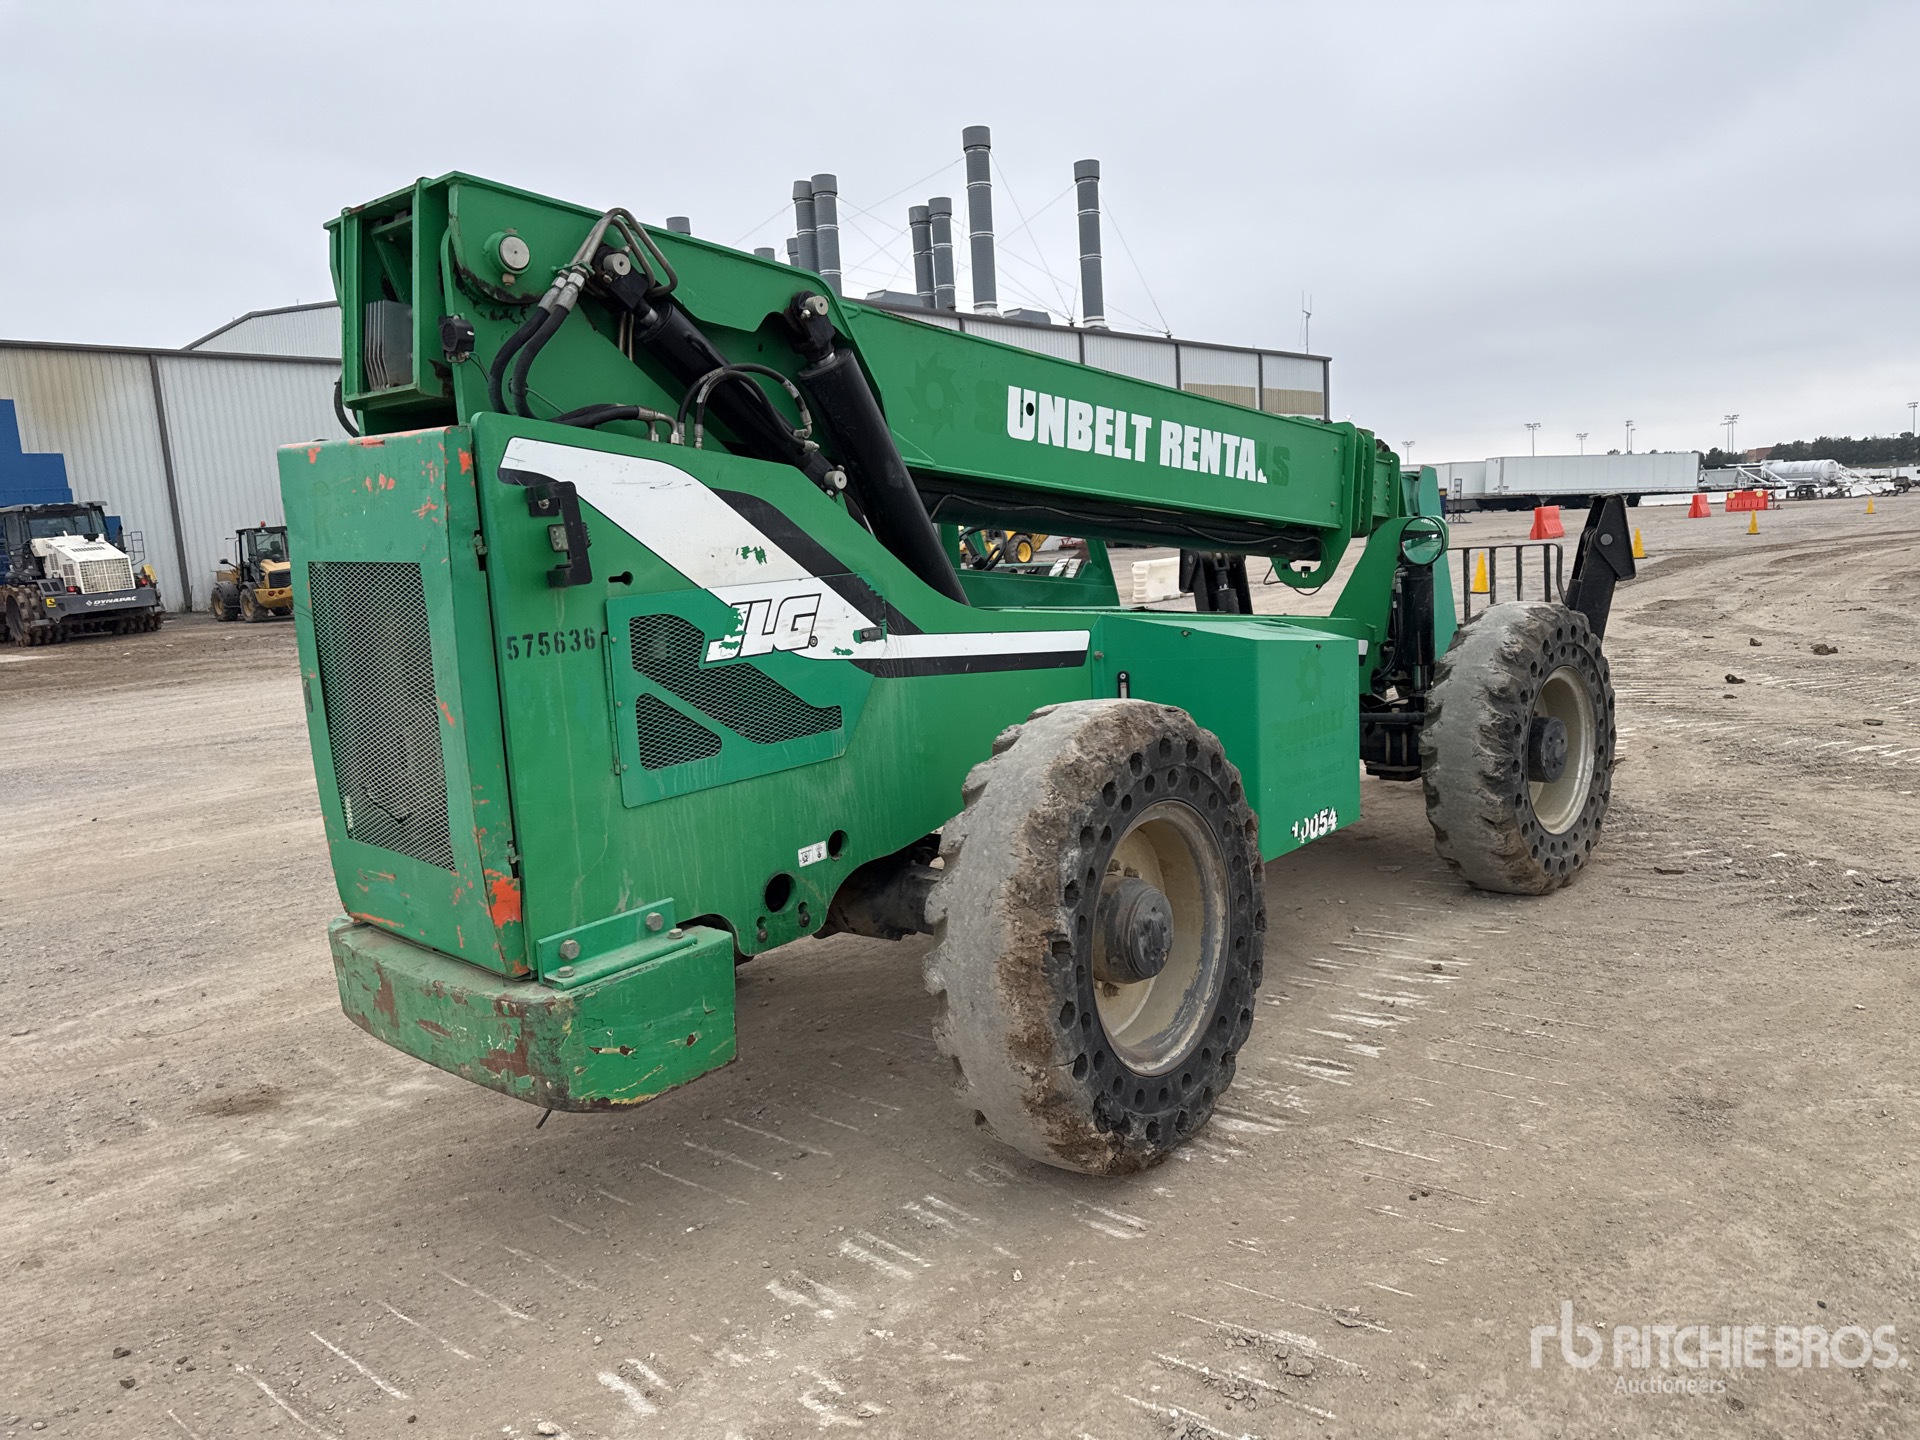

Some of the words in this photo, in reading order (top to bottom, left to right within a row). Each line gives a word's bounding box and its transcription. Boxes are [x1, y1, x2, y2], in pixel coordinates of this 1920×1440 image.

[93, 596, 138, 605] DYNAPAC
[506, 627, 597, 661] 575636
[703, 593, 821, 664] JLG
